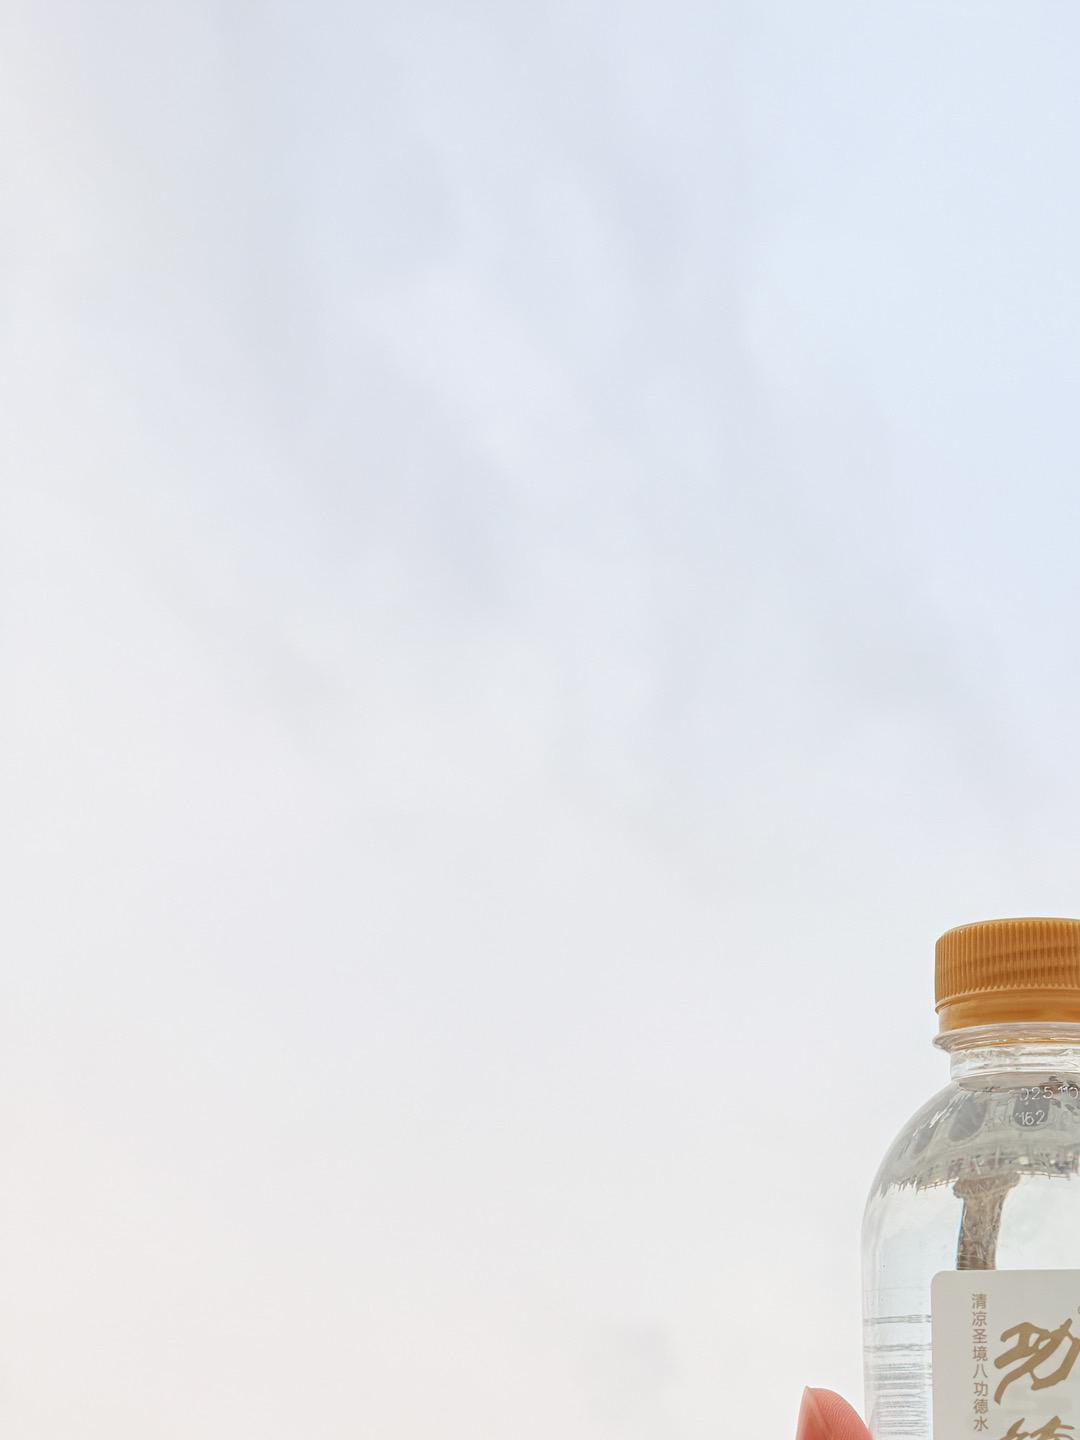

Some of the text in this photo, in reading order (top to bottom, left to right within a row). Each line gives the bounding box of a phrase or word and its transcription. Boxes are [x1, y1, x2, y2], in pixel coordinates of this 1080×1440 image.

[971, 1293, 989, 1432] 清凉圣境八功德水
